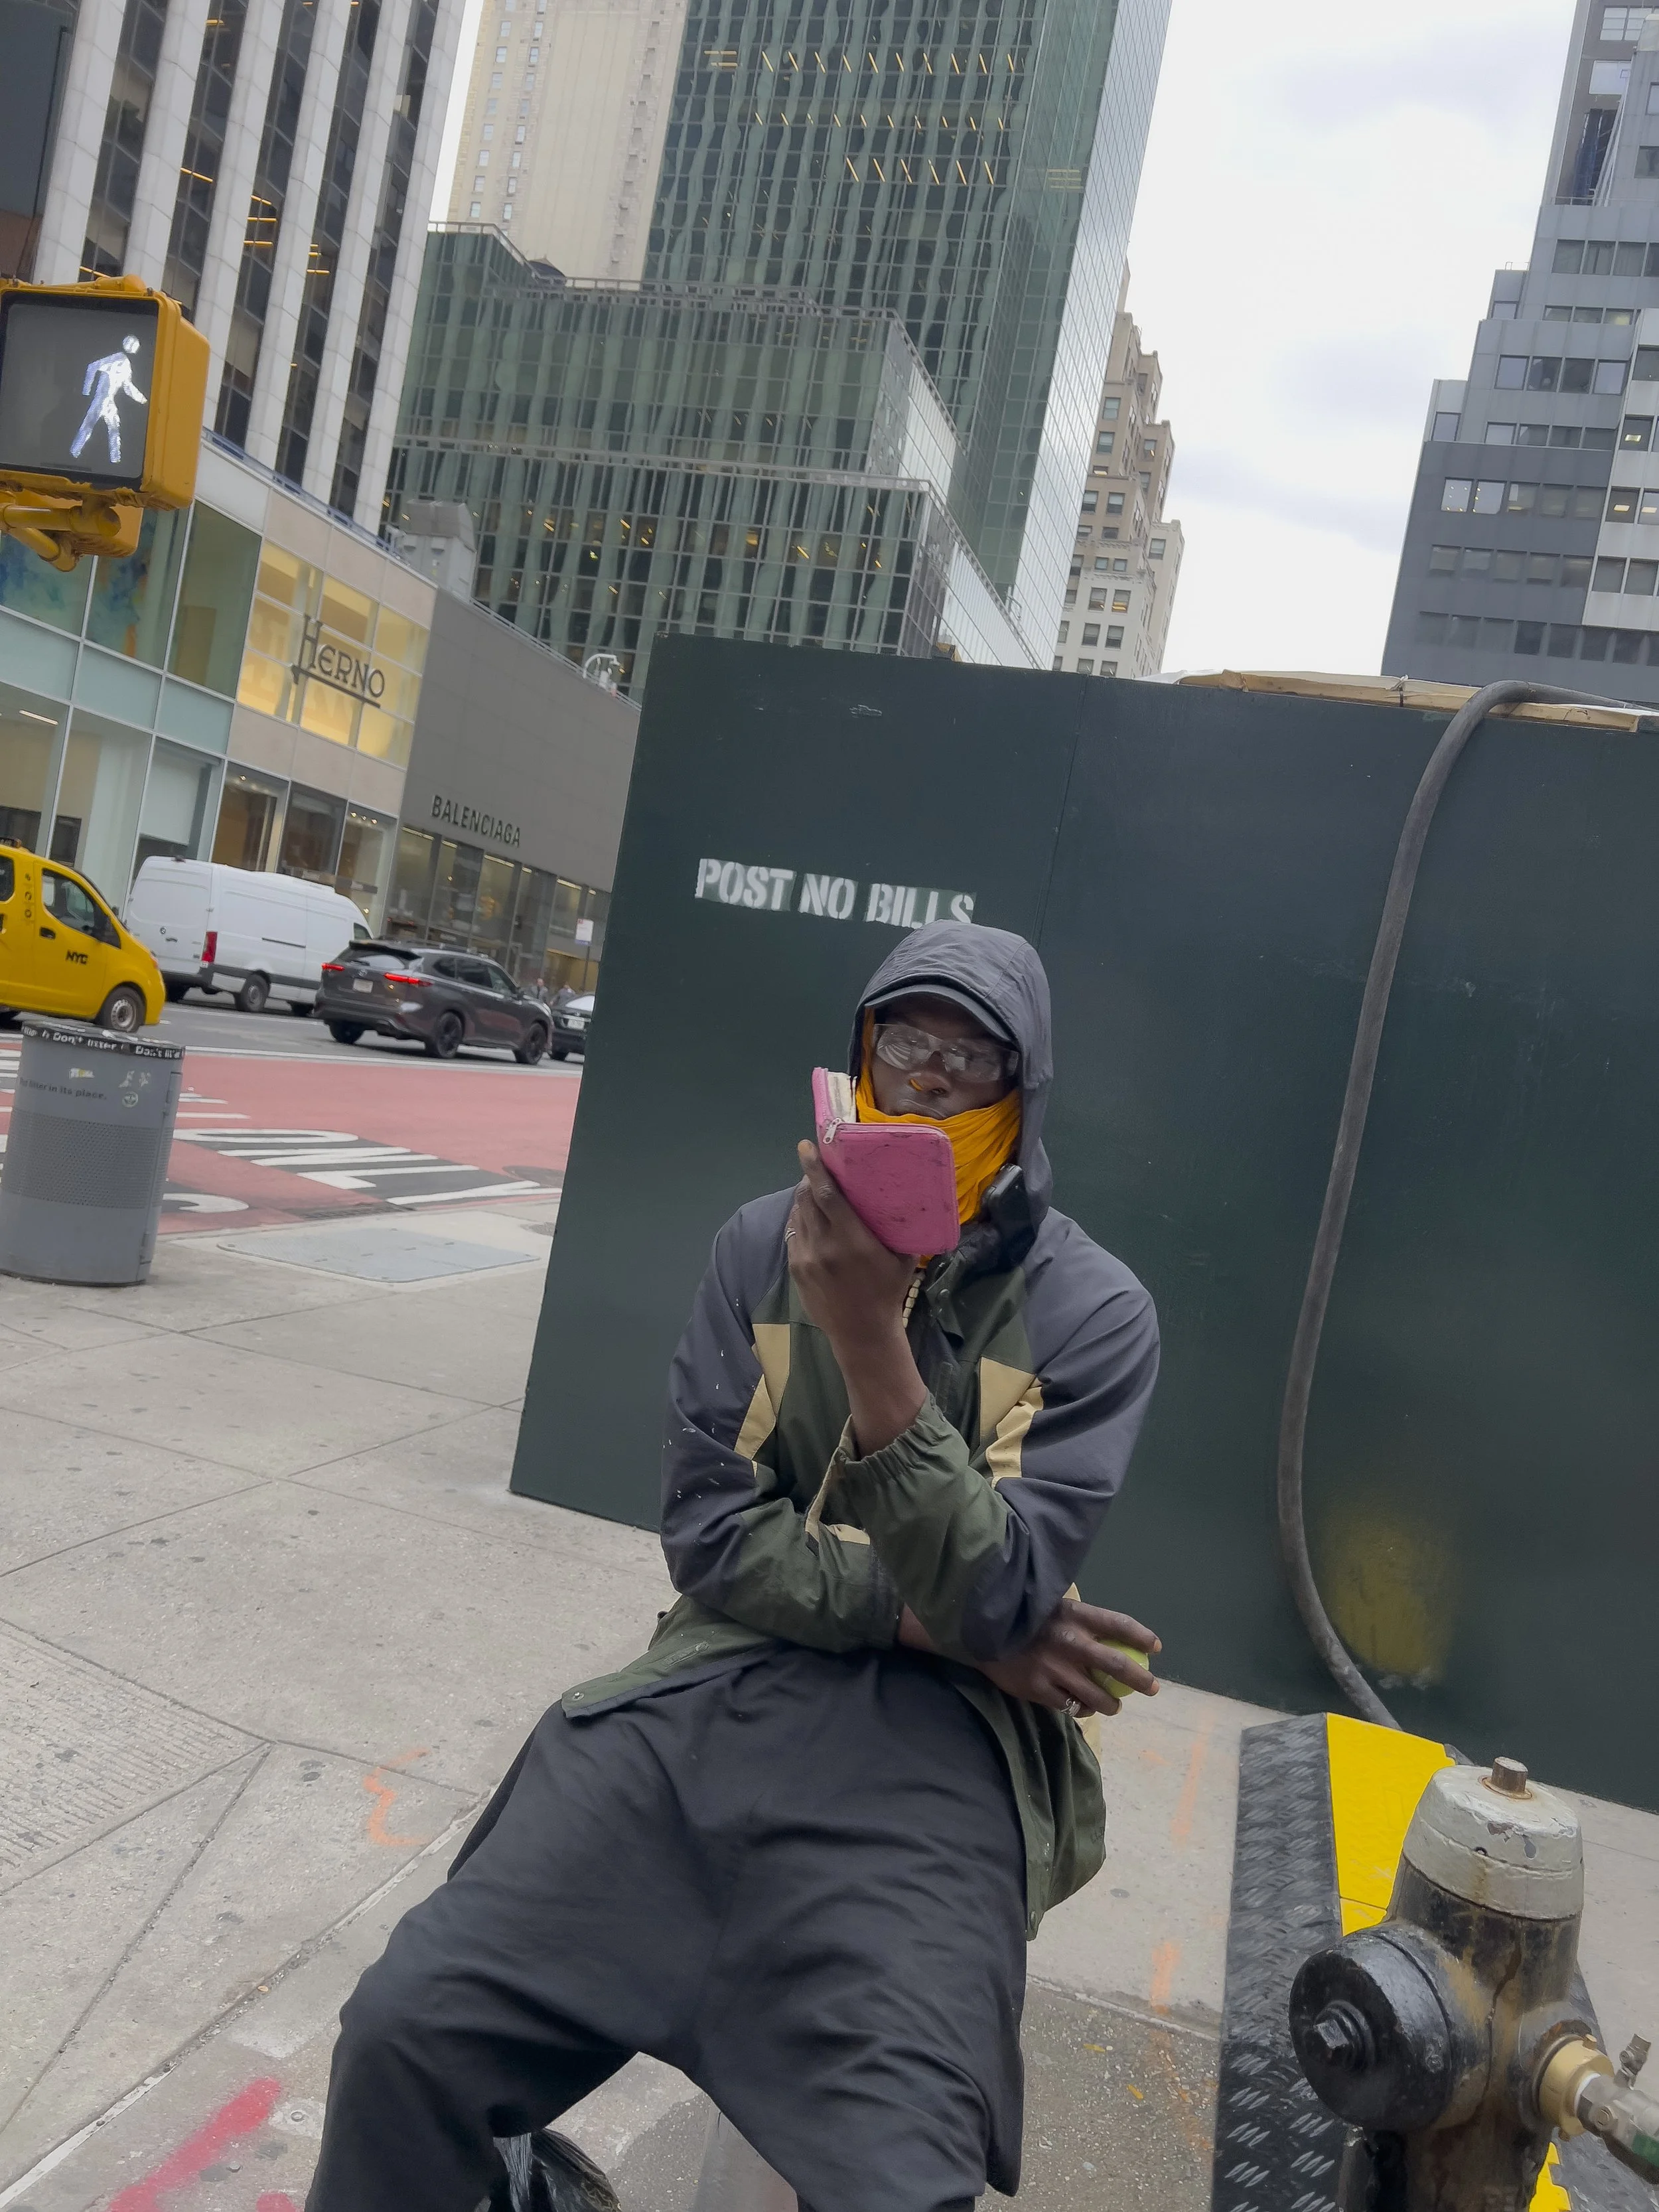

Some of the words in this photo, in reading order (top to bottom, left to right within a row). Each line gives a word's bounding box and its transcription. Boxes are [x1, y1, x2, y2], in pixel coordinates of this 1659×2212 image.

[292, 615, 385, 700] HERNO
[431, 794, 521, 848] BALENCIAGA
[695, 858, 794, 911] POST
[798, 873, 856, 920] NO
[66, 950, 88, 964] NYC
